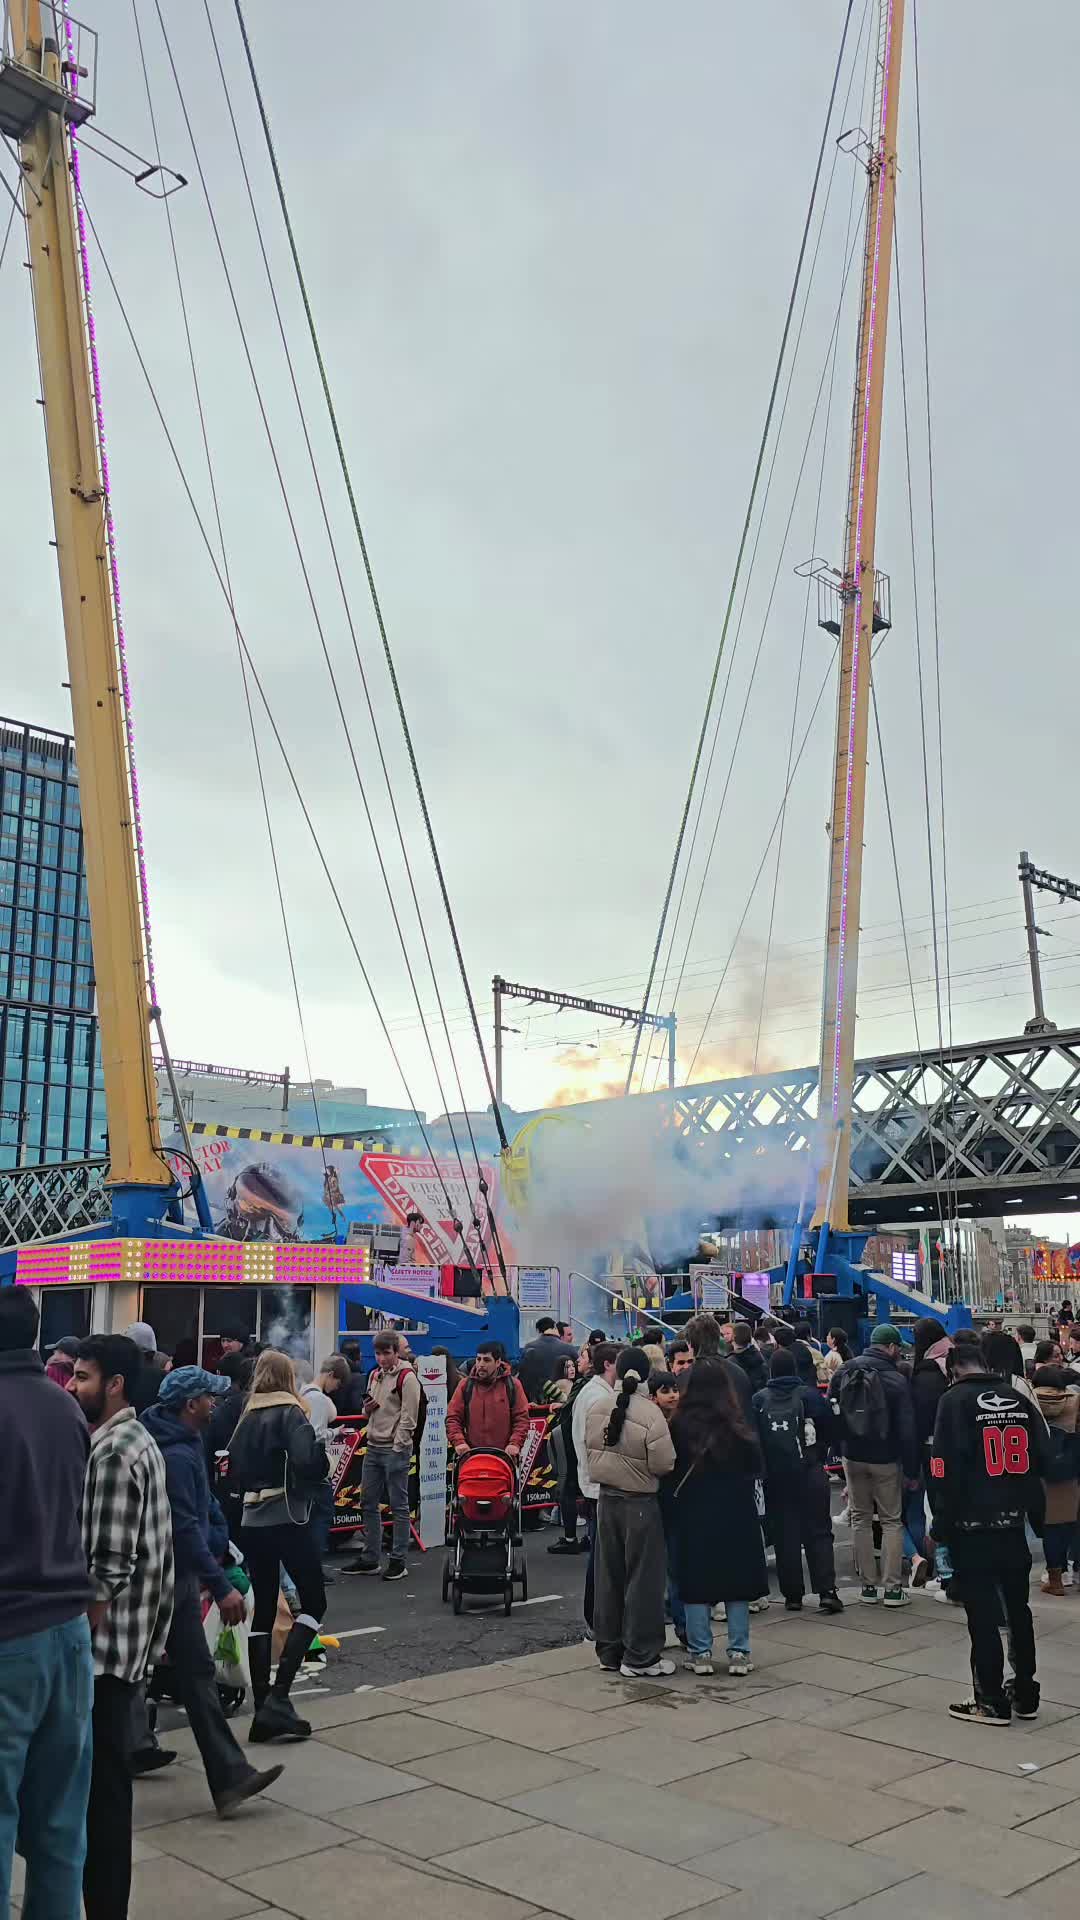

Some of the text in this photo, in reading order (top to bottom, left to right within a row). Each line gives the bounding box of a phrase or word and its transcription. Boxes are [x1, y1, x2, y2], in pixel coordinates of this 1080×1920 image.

[383, 1176, 454, 1265] DAGE
[424, 1367, 440, 1375] 1.4m
[427, 1407, 444, 1417] UST BE
[428, 1420, 439, 1429] THIS
[428, 1434, 440, 1442] TALL
[425, 1446, 443, 1456] TO RIDE
[982, 1424, 1030, 1477] 08
[331, 1444, 352, 1490] NGER
[526, 1491, 551, 1503] 150kmh
[333, 1513, 362, 1525] 150kmh
